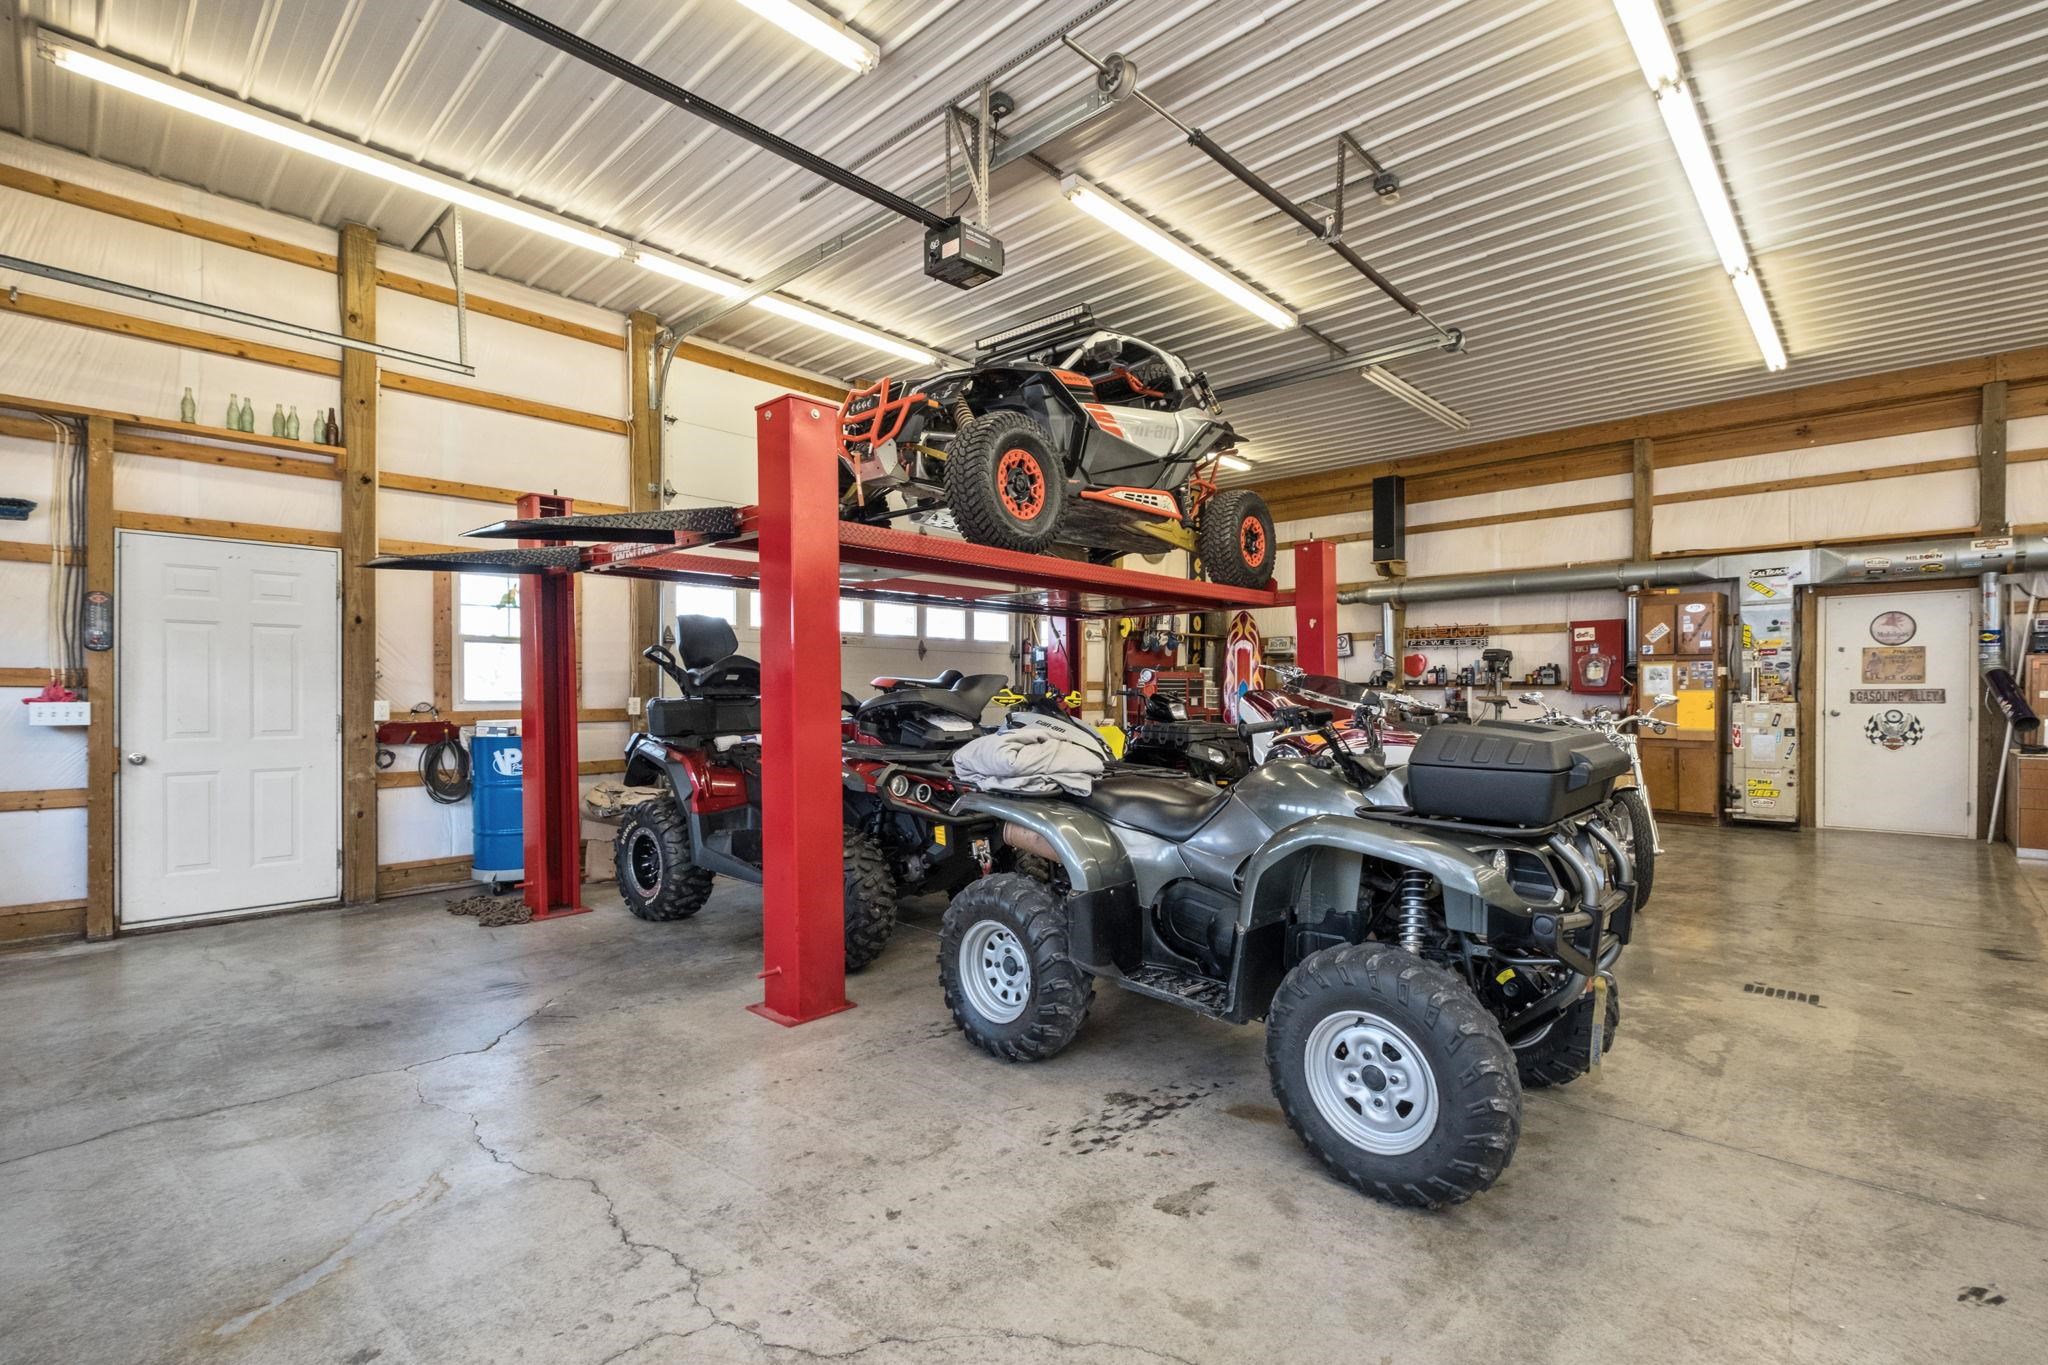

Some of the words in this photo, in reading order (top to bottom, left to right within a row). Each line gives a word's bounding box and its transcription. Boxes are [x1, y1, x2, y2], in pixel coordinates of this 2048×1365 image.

[1856, 690, 1904, 702] GASOLINE
[1908, 690, 1940, 702] ALLEY
[1035, 719, 1067, 734] can-am
[1748, 789, 1780, 798] JEGS
